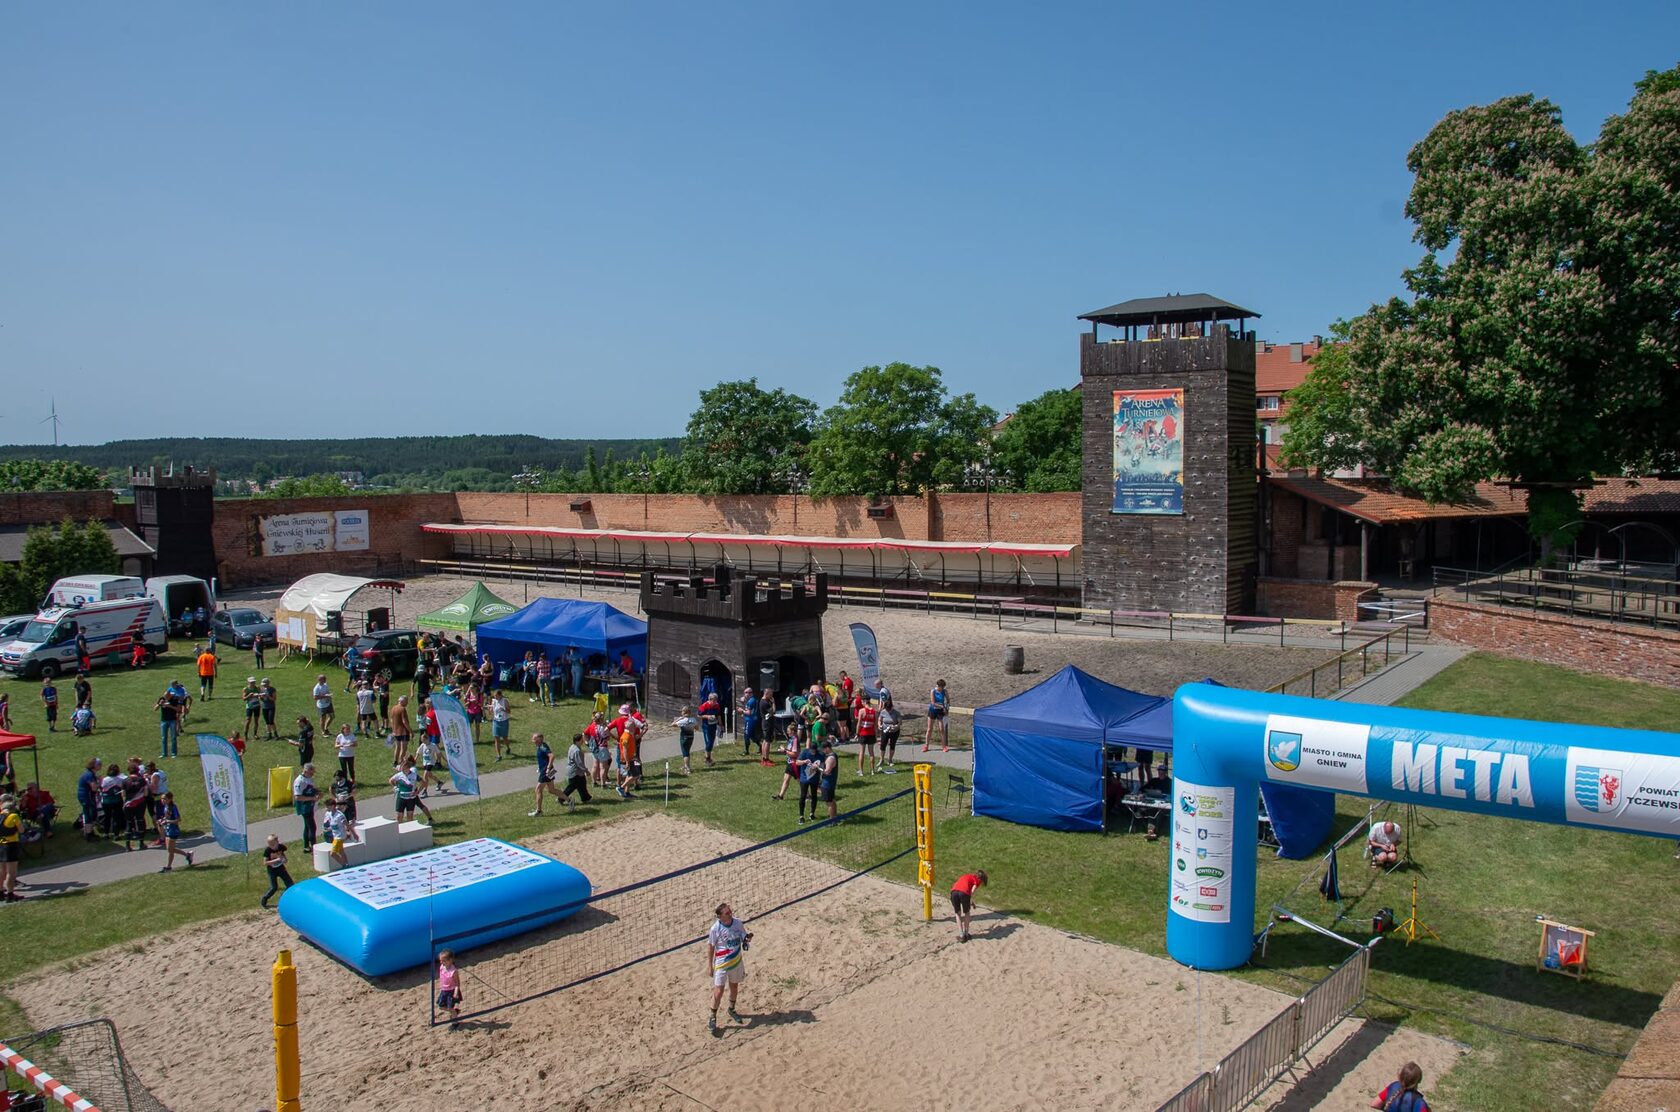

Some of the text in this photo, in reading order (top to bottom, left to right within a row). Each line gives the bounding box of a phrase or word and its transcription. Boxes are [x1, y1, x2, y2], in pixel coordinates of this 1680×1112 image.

[1131, 400, 1165, 409] ARENA
[1121, 408, 1174, 417] TURNIEJOWA
[1302, 746, 1331, 756] MIASTO
[1337, 751, 1363, 760] GMINA
[1316, 758, 1347, 769] GNIEW
[1392, 740, 1535, 808] META
[1639, 786, 1679, 797] POWIAT
[1626, 796, 1680, 810] TCZEWS
